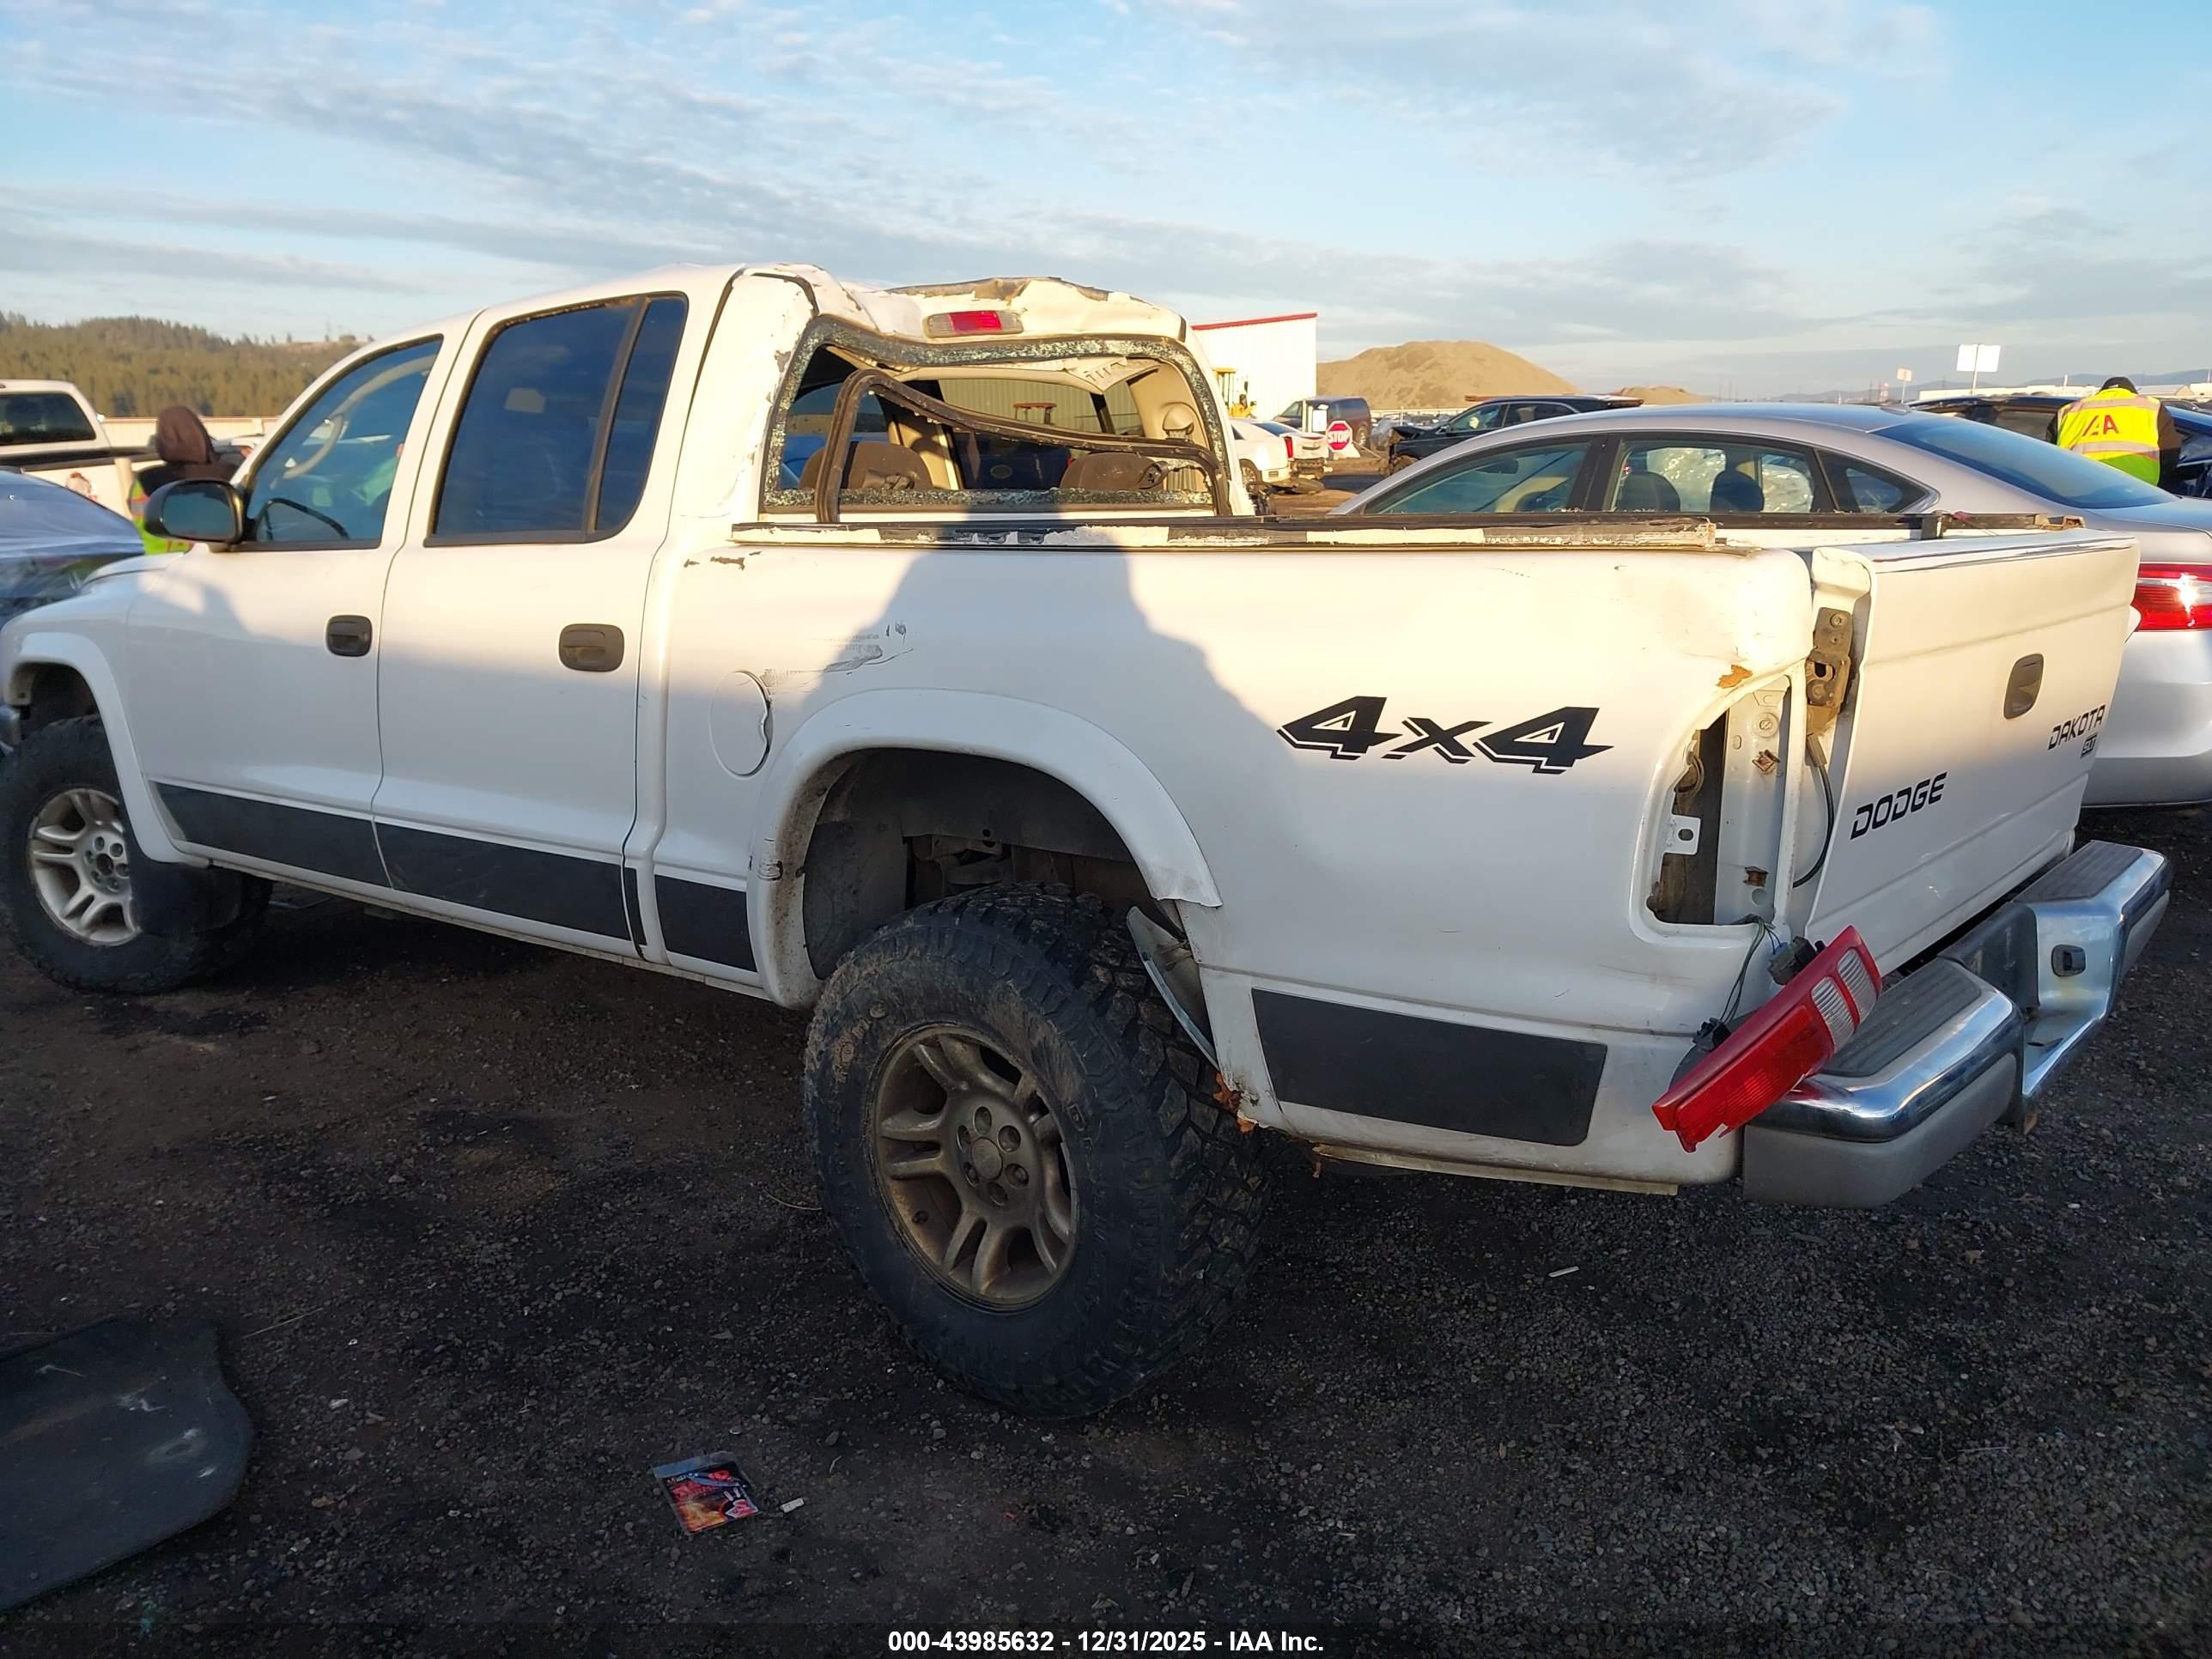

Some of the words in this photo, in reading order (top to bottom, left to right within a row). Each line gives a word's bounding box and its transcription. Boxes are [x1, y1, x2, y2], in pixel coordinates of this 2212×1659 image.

[1327, 430, 1351, 444] STOP
[1277, 696, 1614, 775] 4x4
[2047, 704, 2106, 750] DAKOTA
[1850, 772, 1948, 841] DODGE
